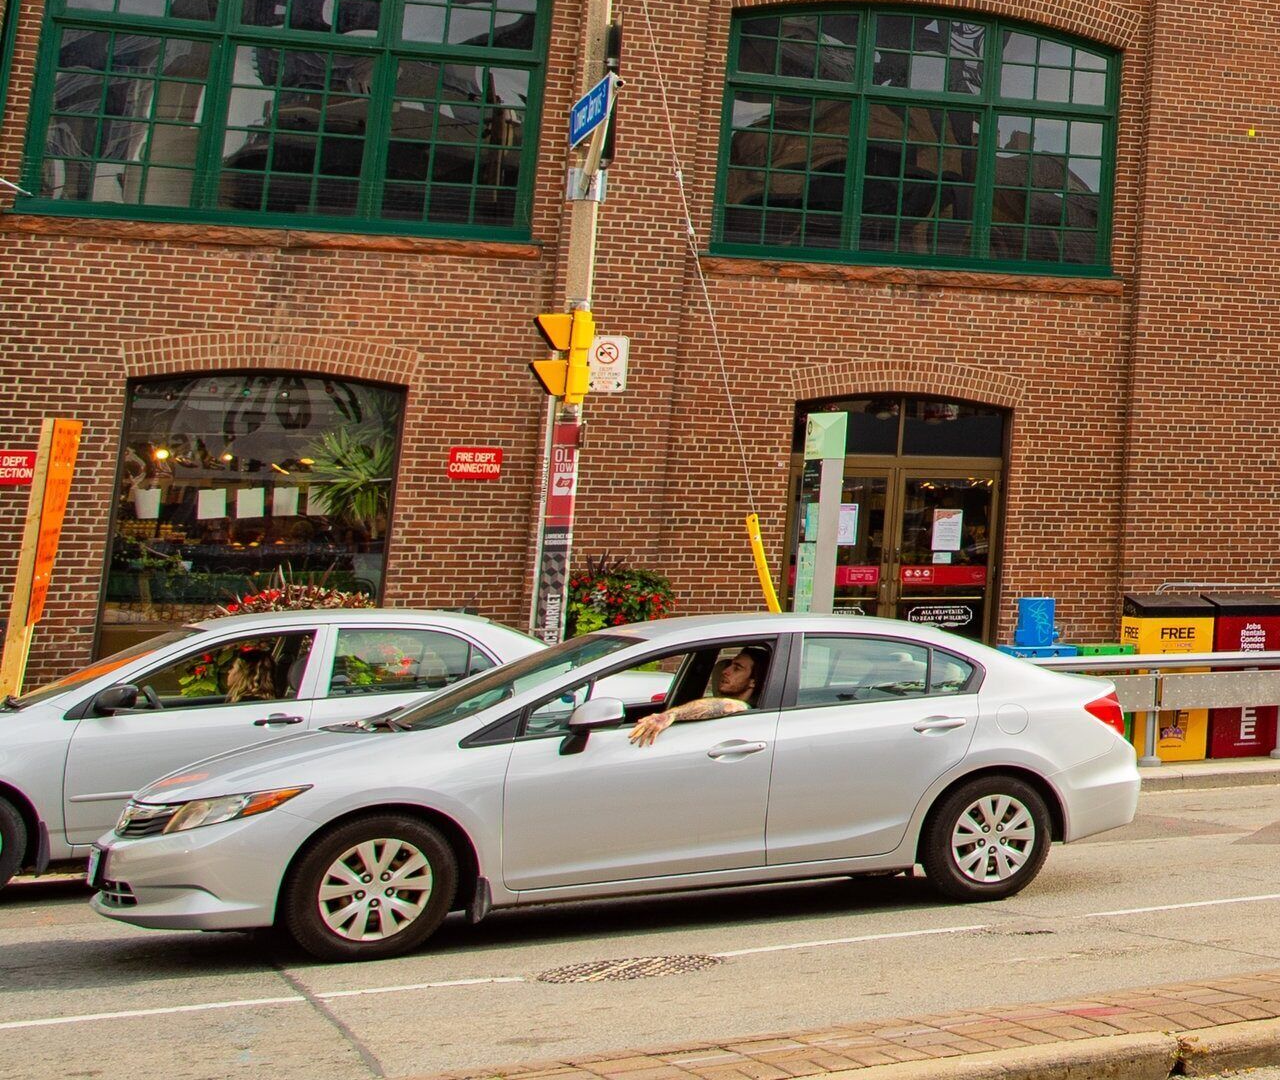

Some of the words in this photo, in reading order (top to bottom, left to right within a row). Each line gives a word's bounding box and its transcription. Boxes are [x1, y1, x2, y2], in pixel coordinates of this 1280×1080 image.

[2, 456, 28, 467] DEPT.
[456, 452, 473, 462] FIRE
[475, 453, 496, 462] DEPT.
[450, 463, 500, 473] CONNECTION
[545, 593, 561, 629] MARKET
[1124, 626, 1139, 639] FREE
[1161, 627, 1195, 639] FREE
